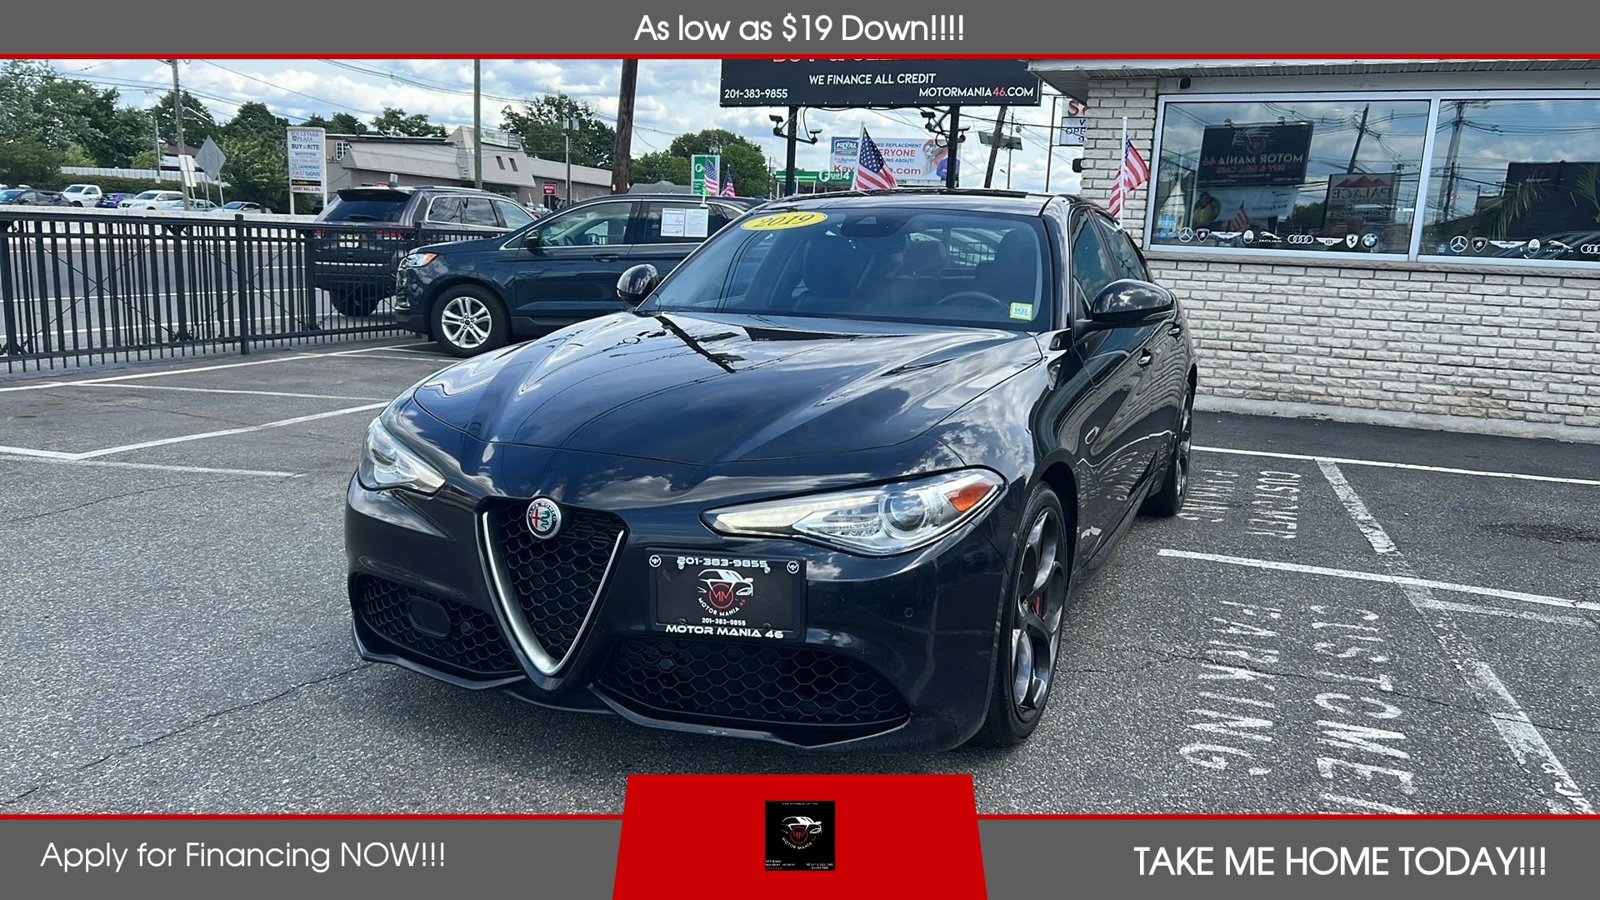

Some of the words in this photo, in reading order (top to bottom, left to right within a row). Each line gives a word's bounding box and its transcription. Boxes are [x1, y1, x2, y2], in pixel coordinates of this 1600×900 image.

[809, 74, 825, 85] WE
[827, 74, 872, 85] FINANCE
[874, 73, 895, 84] ALL
[897, 73, 937, 84] CREDIT
[724, 88, 789, 99] 201-383-9855
[919, 86, 1034, 97] MOTORMANIA46.COM
[1065, 127, 1086, 135] OPE
[307, 143, 320, 151] RITE
[753, 214, 815, 228] 2019
[676, 556, 769, 569] 201-383-9855
[698, 597, 718, 616] MOTOR
[719, 606, 740, 616] MANIA
[701, 617, 747, 627] 201-383-9855
[665, 624, 714, 636] MOTOR
[716, 627, 762, 638] MANIA
[764, 630, 784, 639] 46
